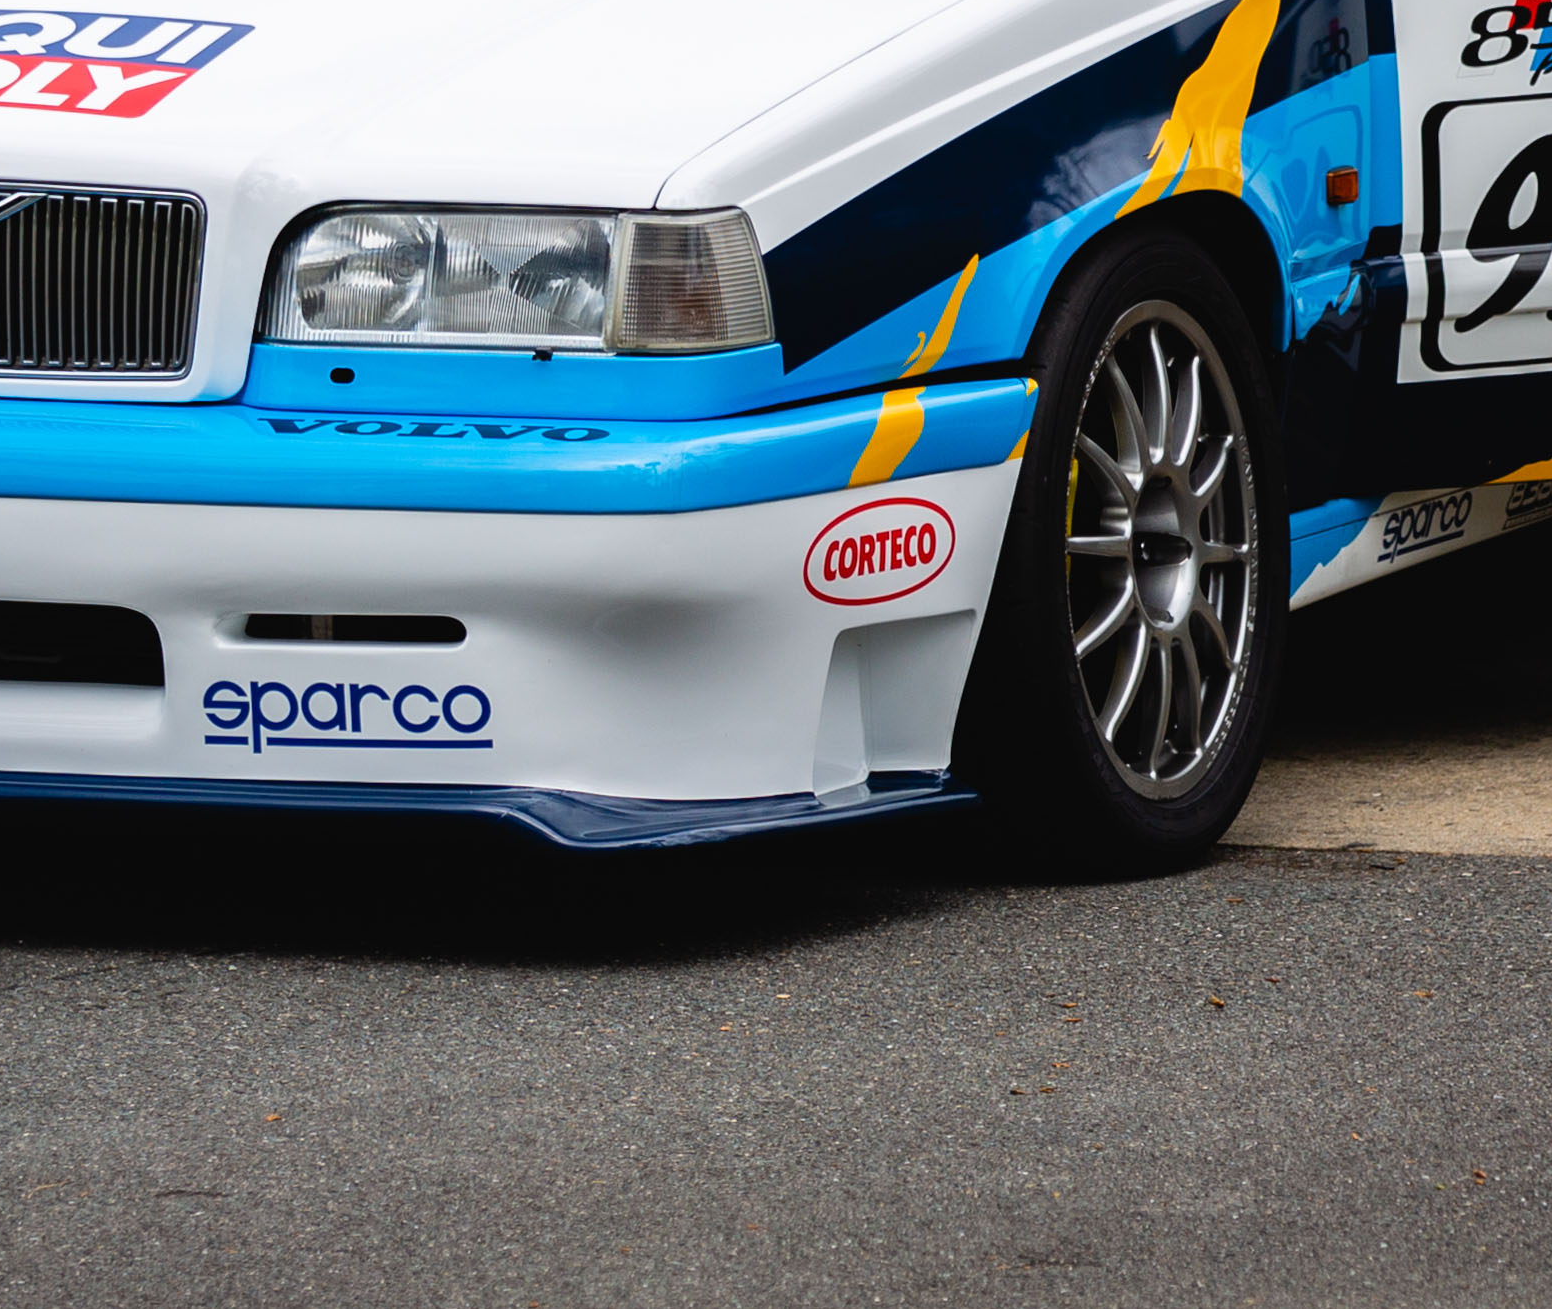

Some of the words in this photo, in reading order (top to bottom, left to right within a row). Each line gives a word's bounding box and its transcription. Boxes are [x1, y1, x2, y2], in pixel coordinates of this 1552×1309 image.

[257, 417, 611, 442] VOLVO
[824, 522, 937, 583] CORTECO
[1377, 492, 1473, 563] sparco
[203, 680, 494, 753] sparco
